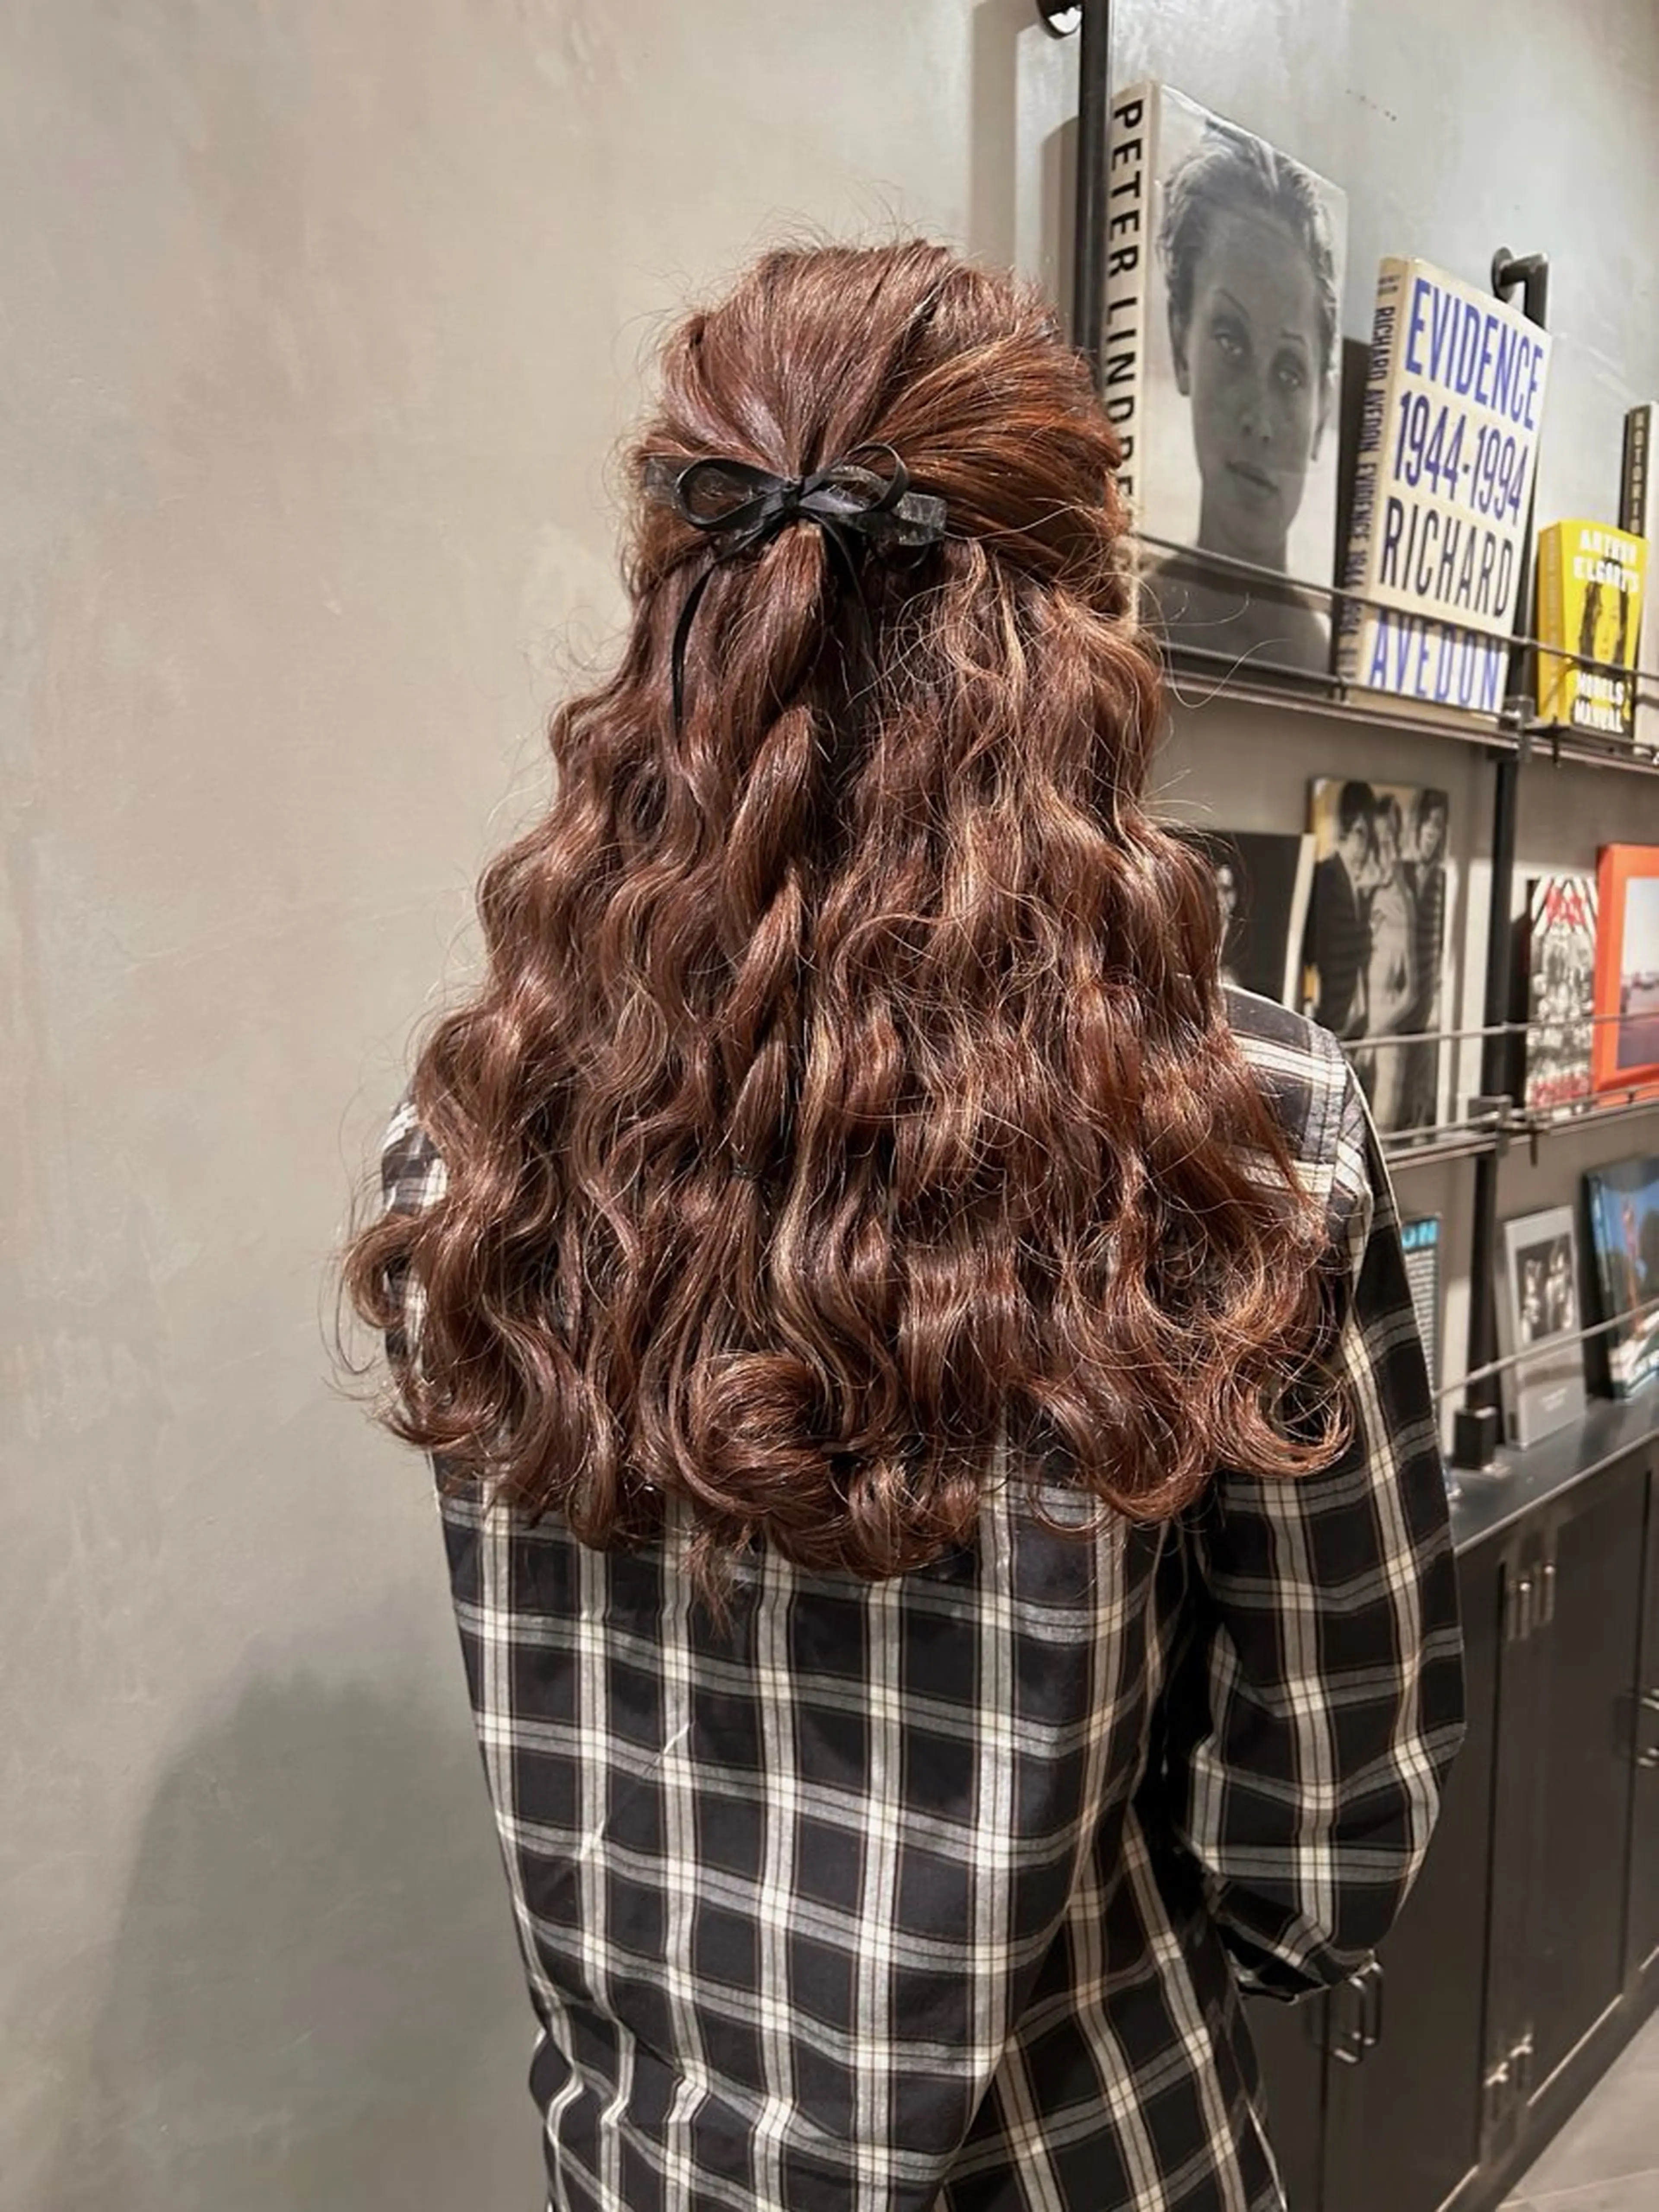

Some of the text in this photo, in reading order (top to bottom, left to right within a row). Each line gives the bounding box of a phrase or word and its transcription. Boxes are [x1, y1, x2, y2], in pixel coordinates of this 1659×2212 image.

[1108, 99, 1143, 278] PETER
[1405, 278, 1544, 431] EVIDENCE
[1393, 390, 1529, 526] 1944-1994
[1379, 496, 1513, 617] RICHARD
[1370, 606, 1500, 710] AVEDON
